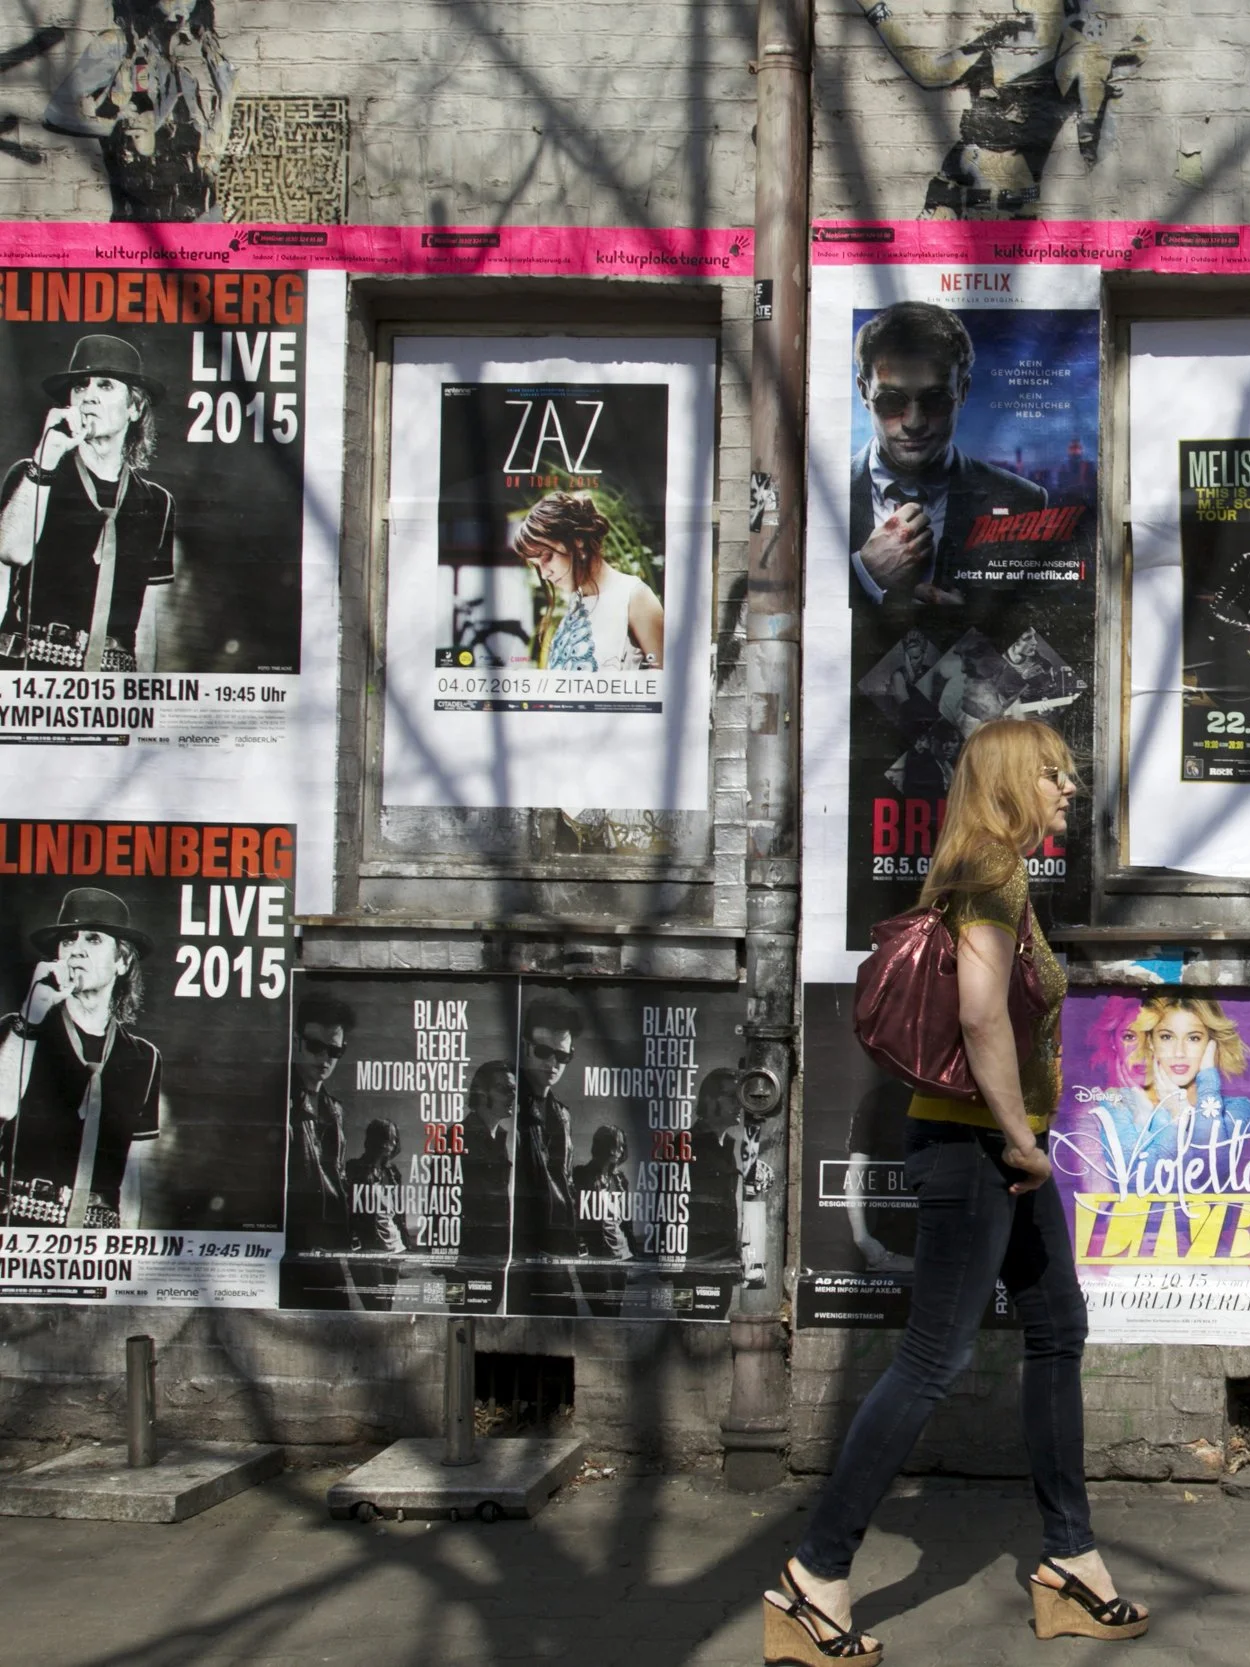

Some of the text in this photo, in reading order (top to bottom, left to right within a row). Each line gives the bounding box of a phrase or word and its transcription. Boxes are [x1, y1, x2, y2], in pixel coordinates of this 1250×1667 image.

[95, 245, 230, 264] kulturplakatierung
[596, 250, 729, 269] kulturplakatierung
[994, 243, 1132, 262] kulturplakatierung
[941, 273, 1011, 292] NETFLIX
[5, 272, 304, 325] LINDENBERG
[192, 331, 297, 383] LIVE
[1019, 360, 1043, 368] KEIN
[990, 368, 1071, 377] GEWÖHNLICHER
[1008, 378, 1053, 386] MENSCH.
[990, 400, 1071, 410] GEWÖHNLICHER
[1019, 392, 1042, 400] KEIN
[187, 391, 298, 444] 2015
[503, 399, 604, 474] ZAZ
[569, 476, 600, 489] 2015
[1196, 488, 1248, 499] THIS IS
[1196, 510, 1237, 521] TOUR
[1197, 499, 1230, 510] M.E.
[954, 569, 1080, 581] Jetzt nur auf netflix.de
[988, 560, 1080, 568] ALLE FOLGEN ANSEHEN
[12, 677, 287, 703] 14.7.2015 BERLIN 19:45 Uhr
[438, 678, 657, 695] 04.07.2015 ZITADELLE
[0, 823, 293, 880] LINDENBERG
[180, 884, 285, 937] LIVE
[174, 945, 286, 999] 2015
[414, 1000, 468, 1030] BLACK
[643, 1006, 697, 1037] BLACK
[416, 1030, 471, 1061] REBEL
[645, 1038, 699, 1069] REBEL
[356, 1061, 468, 1092] MOTORCYCLE
[584, 1066, 696, 1100] MOTORCYCLE
[420, 1093, 465, 1123] CLUB
[648, 1100, 691, 1130] CLUB
[424, 1123, 469, 1155] 26.6.
[652, 1130, 697, 1162] 26.6.
[409, 1155, 464, 1185] ASTRA
[636, 1161, 691, 1192] ASTRA
[843, 1170, 877, 1191] AXE
[352, 1183, 462, 1215] KULTURHAUS
[579, 1190, 689, 1223] KULTURHAUS
[819, 1200, 857, 1208] DESIGNED
[416, 1216, 460, 1246] 21:00
[643, 1223, 688, 1254] 21:00
[104, 1235, 272, 1258] BERLIN 19:45 Uhr
[1101, 1290, 1182, 1311] WORLD
